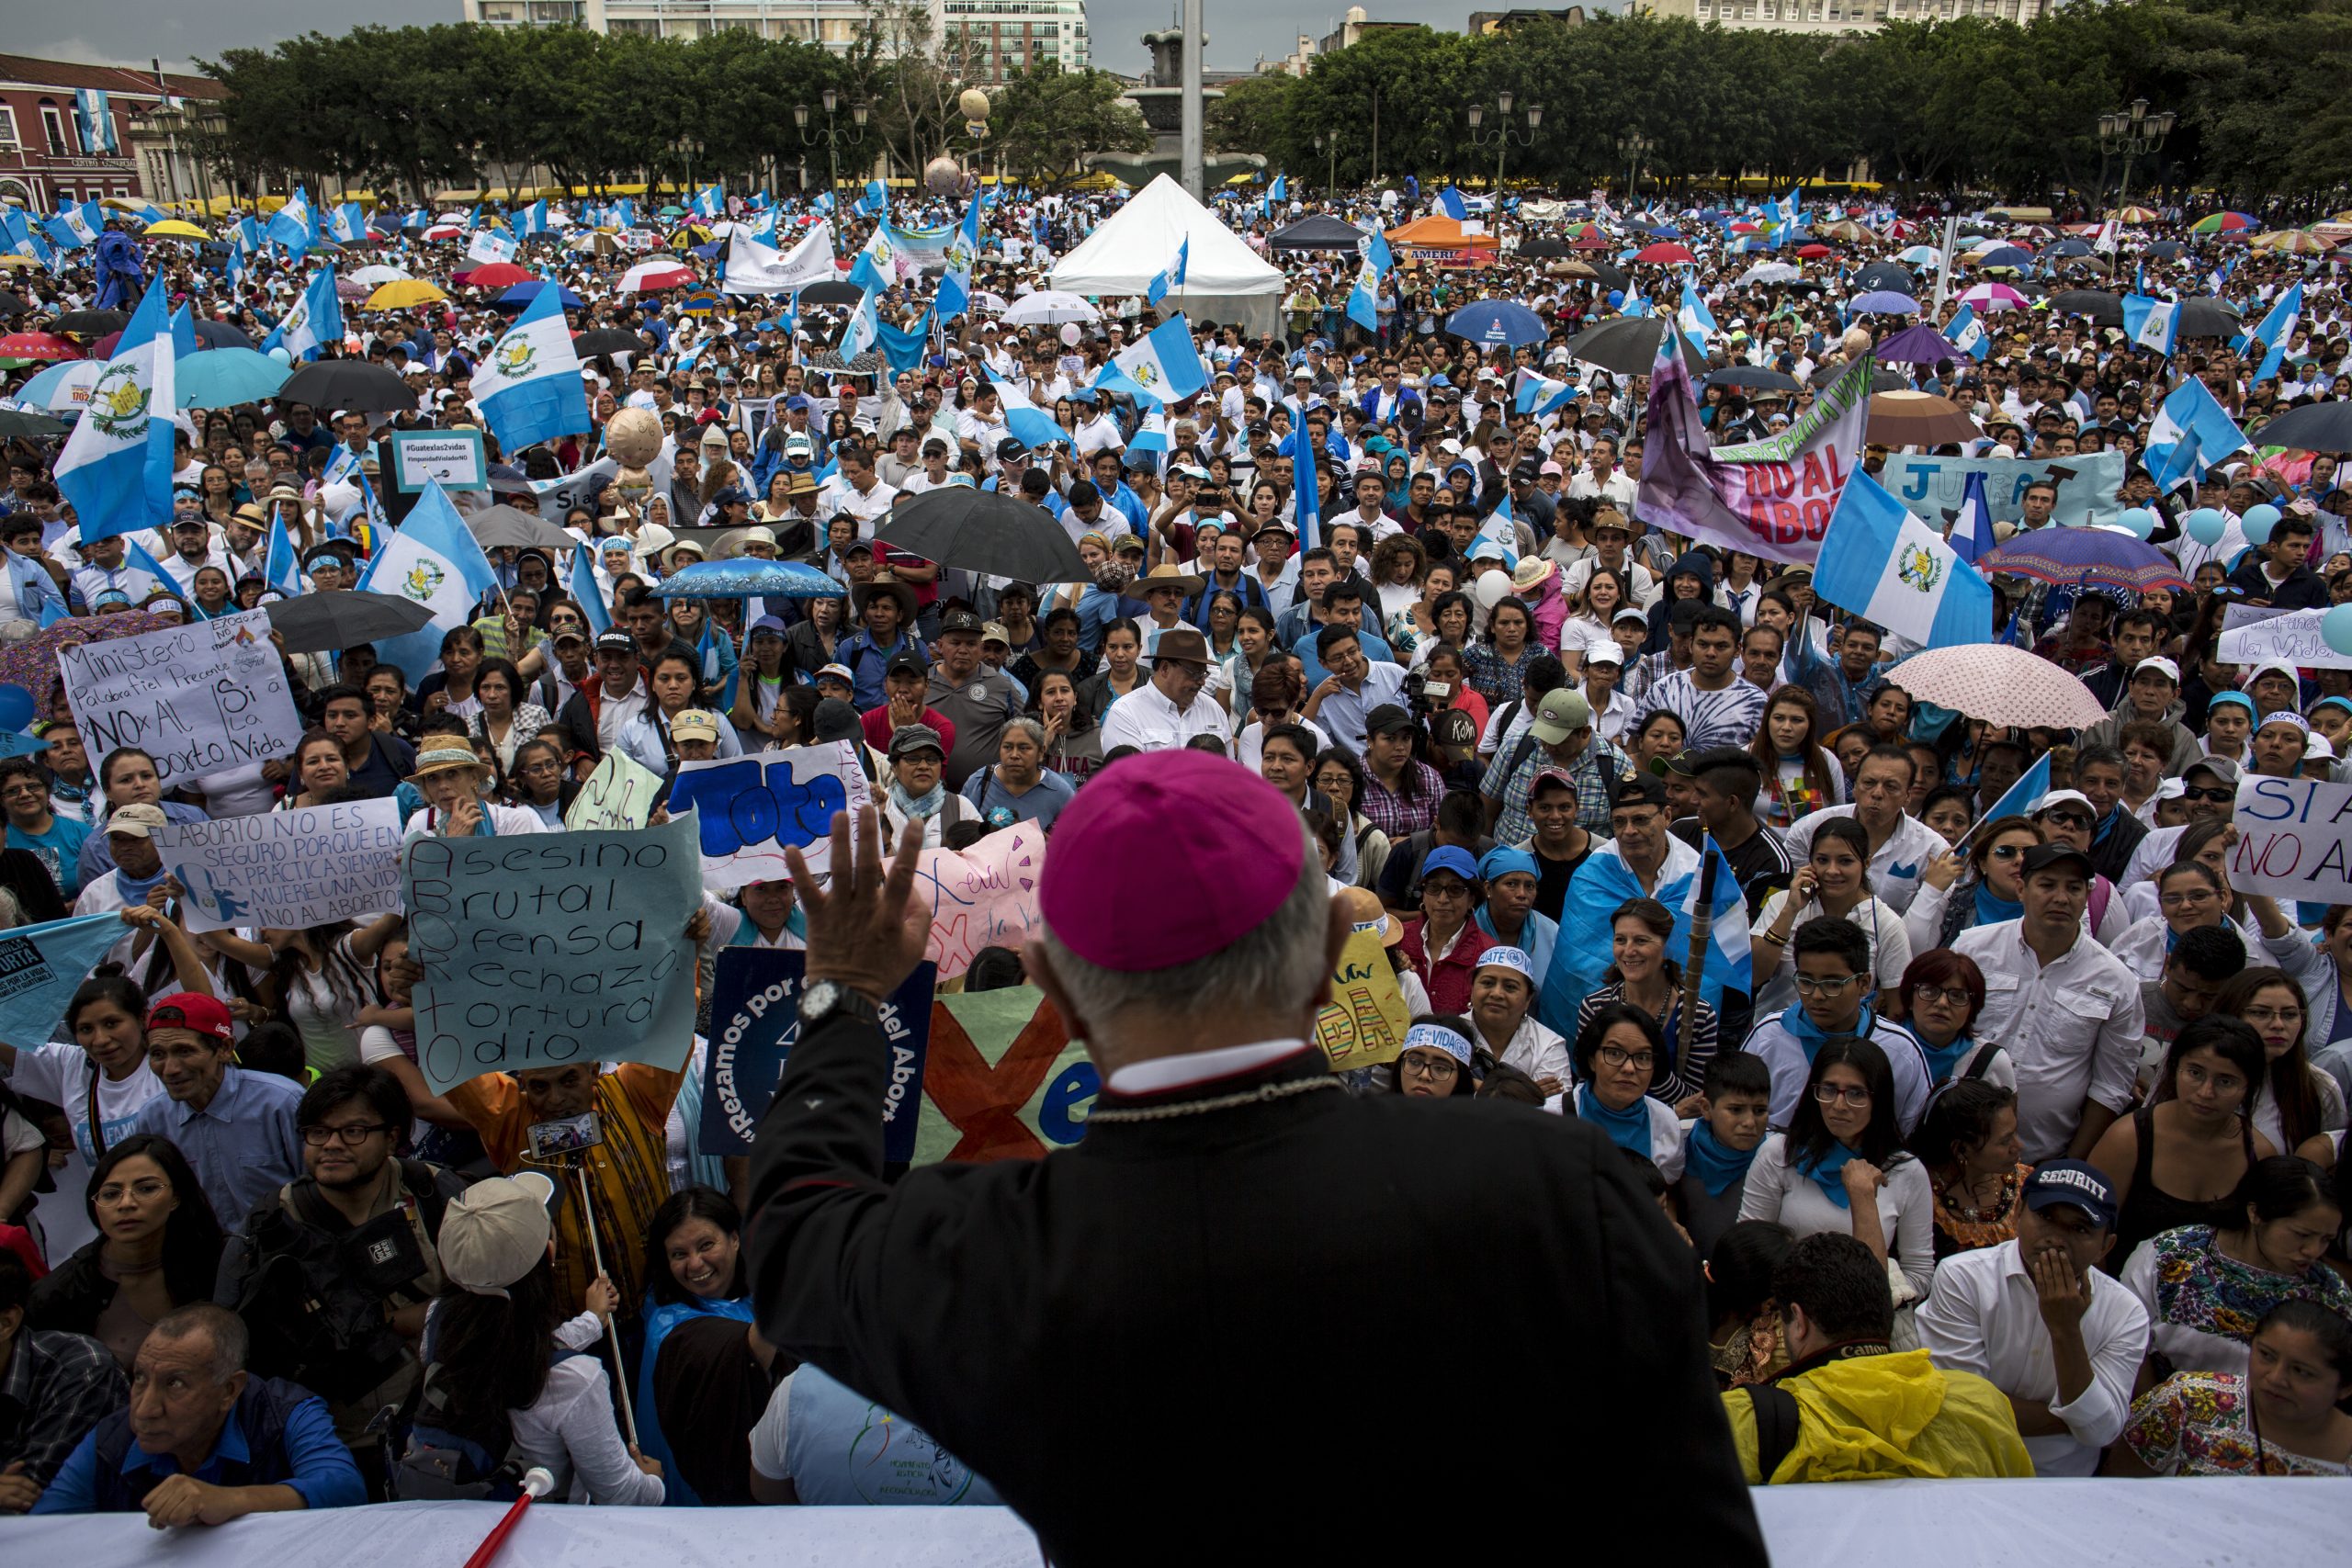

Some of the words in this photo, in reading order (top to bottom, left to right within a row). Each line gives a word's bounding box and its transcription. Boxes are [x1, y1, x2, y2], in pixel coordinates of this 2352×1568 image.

[406, 444, 467, 452] #Guatexlas2vidas
[1746, 461, 1795, 498] NO
[1804, 443, 1848, 498] AL
[556, 491, 577, 509] Si
[1748, 494, 1841, 545] ABO
[216, 628, 231, 639] NO
[599, 633, 629, 642] RAIDERS
[2239, 633, 2261, 657] la
[2272, 633, 2334, 659] Vida
[63, 633, 195, 686] Ministerio
[217, 679, 256, 714] Si
[268, 682, 282, 693] a
[230, 732, 286, 764] Vida
[667, 760, 847, 859] Toto
[2239, 780, 2318, 823] SI
[148, 827, 175, 848] EL
[179, 816, 263, 848] ABORTO
[275, 812, 316, 838] NO
[333, 806, 365, 829] ES
[204, 841, 287, 868] SEGURO
[294, 829, 368, 859] PORQUE
[377, 827, 401, 847] EN
[2233, 830, 2301, 878] NO
[2304, 838, 2352, 884] A
[212, 870, 241, 887] LA
[251, 883, 320, 906] MUERE
[322, 876, 361, 898] UNA
[301, 904, 324, 924] AL
[1351, 921, 1374, 933] ATE
[7, 976, 21, 987] POR
[20, 972, 29, 982] LA
[745, 976, 797, 1018] por
[876, 1000, 910, 1043] del
[1433, 1031, 1455, 1050] VIDA
[426, 1031, 580, 1084] Odio
[882, 1044, 917, 1127] Abort
[2039, 1168, 2108, 1201] SECURITY
[1840, 1345, 1889, 1358] Canon
